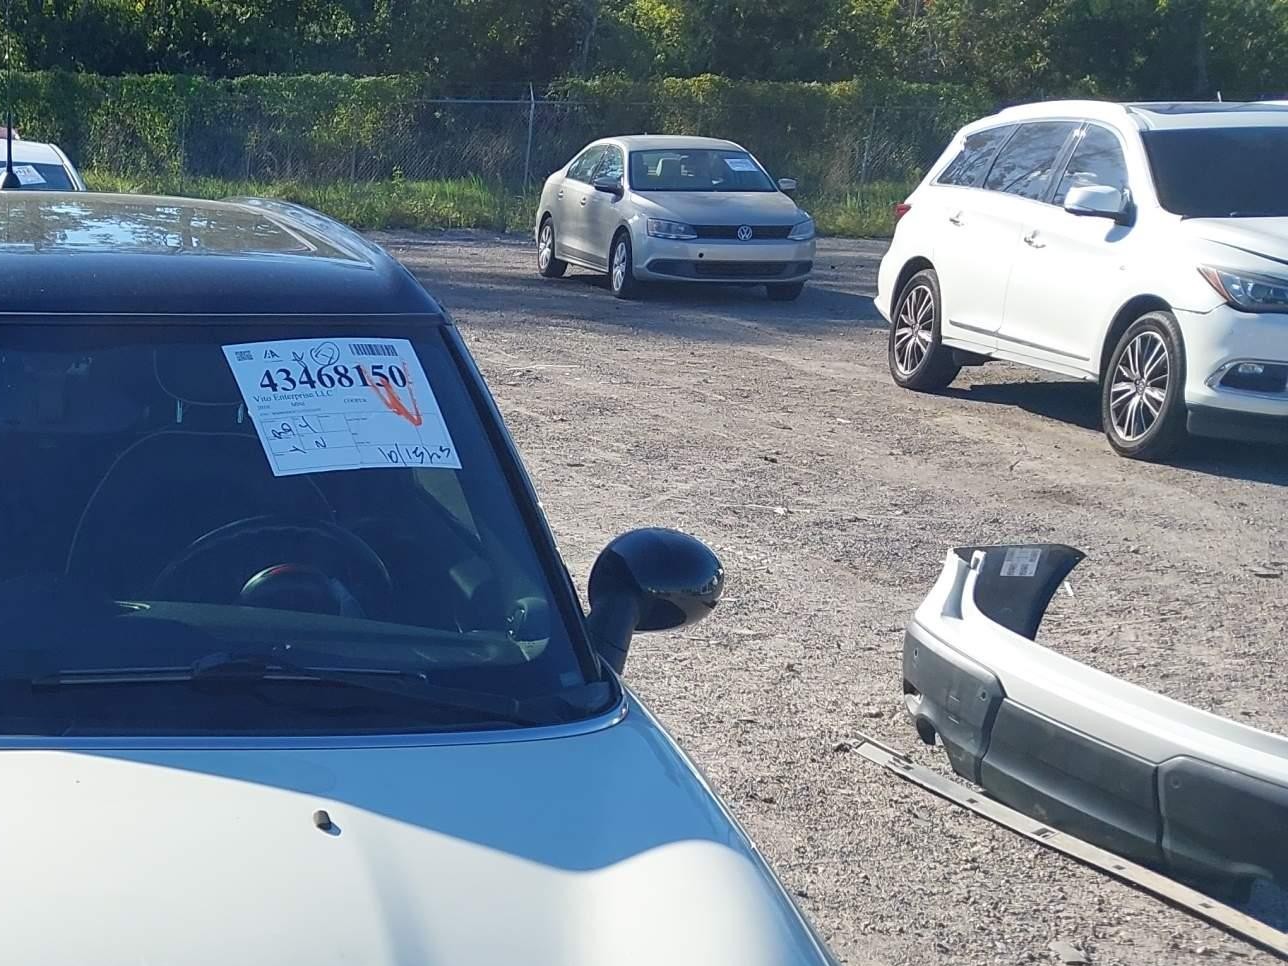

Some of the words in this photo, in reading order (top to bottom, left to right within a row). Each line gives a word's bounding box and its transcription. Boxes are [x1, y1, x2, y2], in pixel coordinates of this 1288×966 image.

[260, 364, 406, 391] 43468150
[253, 394, 272, 403] Vito
[273, 391, 314, 402] Enterprise
[315, 389, 334, 398] LLC
